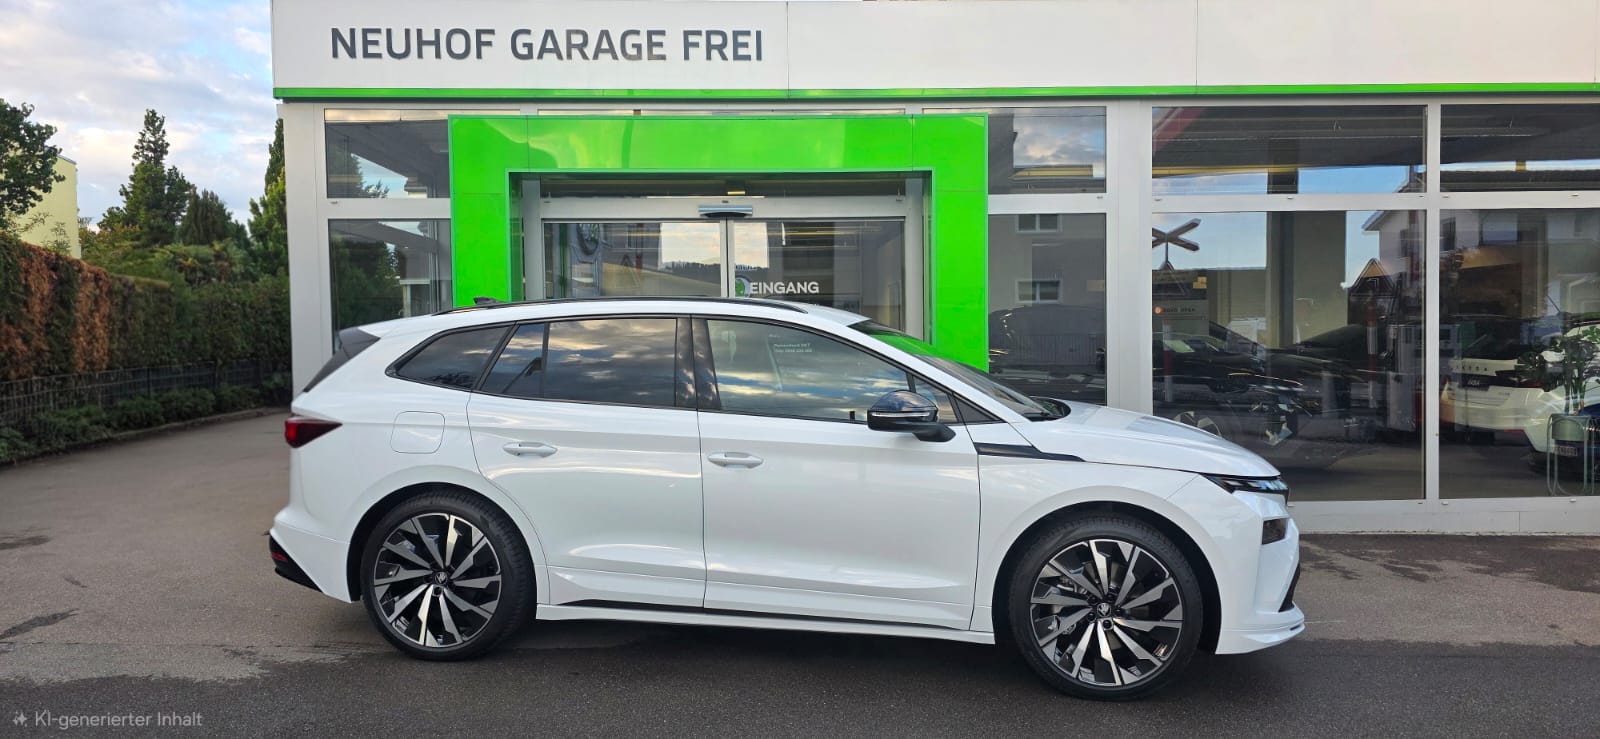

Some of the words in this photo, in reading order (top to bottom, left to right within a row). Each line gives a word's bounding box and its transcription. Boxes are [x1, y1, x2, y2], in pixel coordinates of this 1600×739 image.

[331, 27, 496, 61] NEUHOF
[510, 28, 667, 61] GARAGE
[682, 29, 763, 61] FREI
[750, 281, 820, 294] EINGANG
